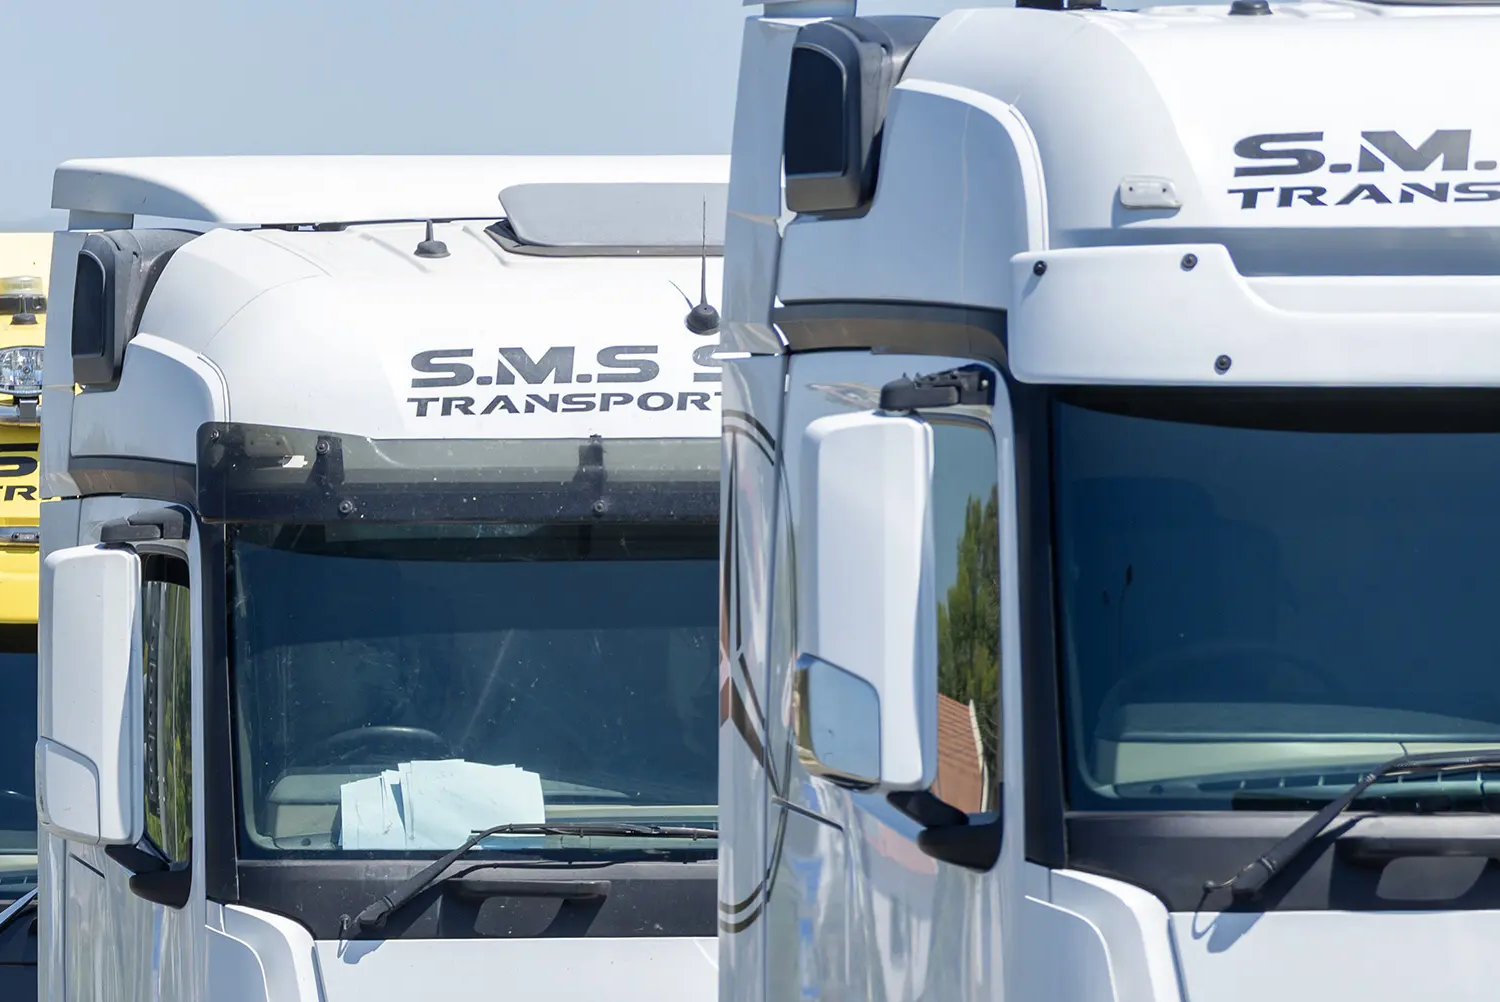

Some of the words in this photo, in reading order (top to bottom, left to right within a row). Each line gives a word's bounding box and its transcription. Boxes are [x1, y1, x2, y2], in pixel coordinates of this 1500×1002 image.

[1227, 182, 1500, 210] TRANS
[410, 345, 660, 388] S.M.S
[406, 391, 722, 417] TRANSPOR
